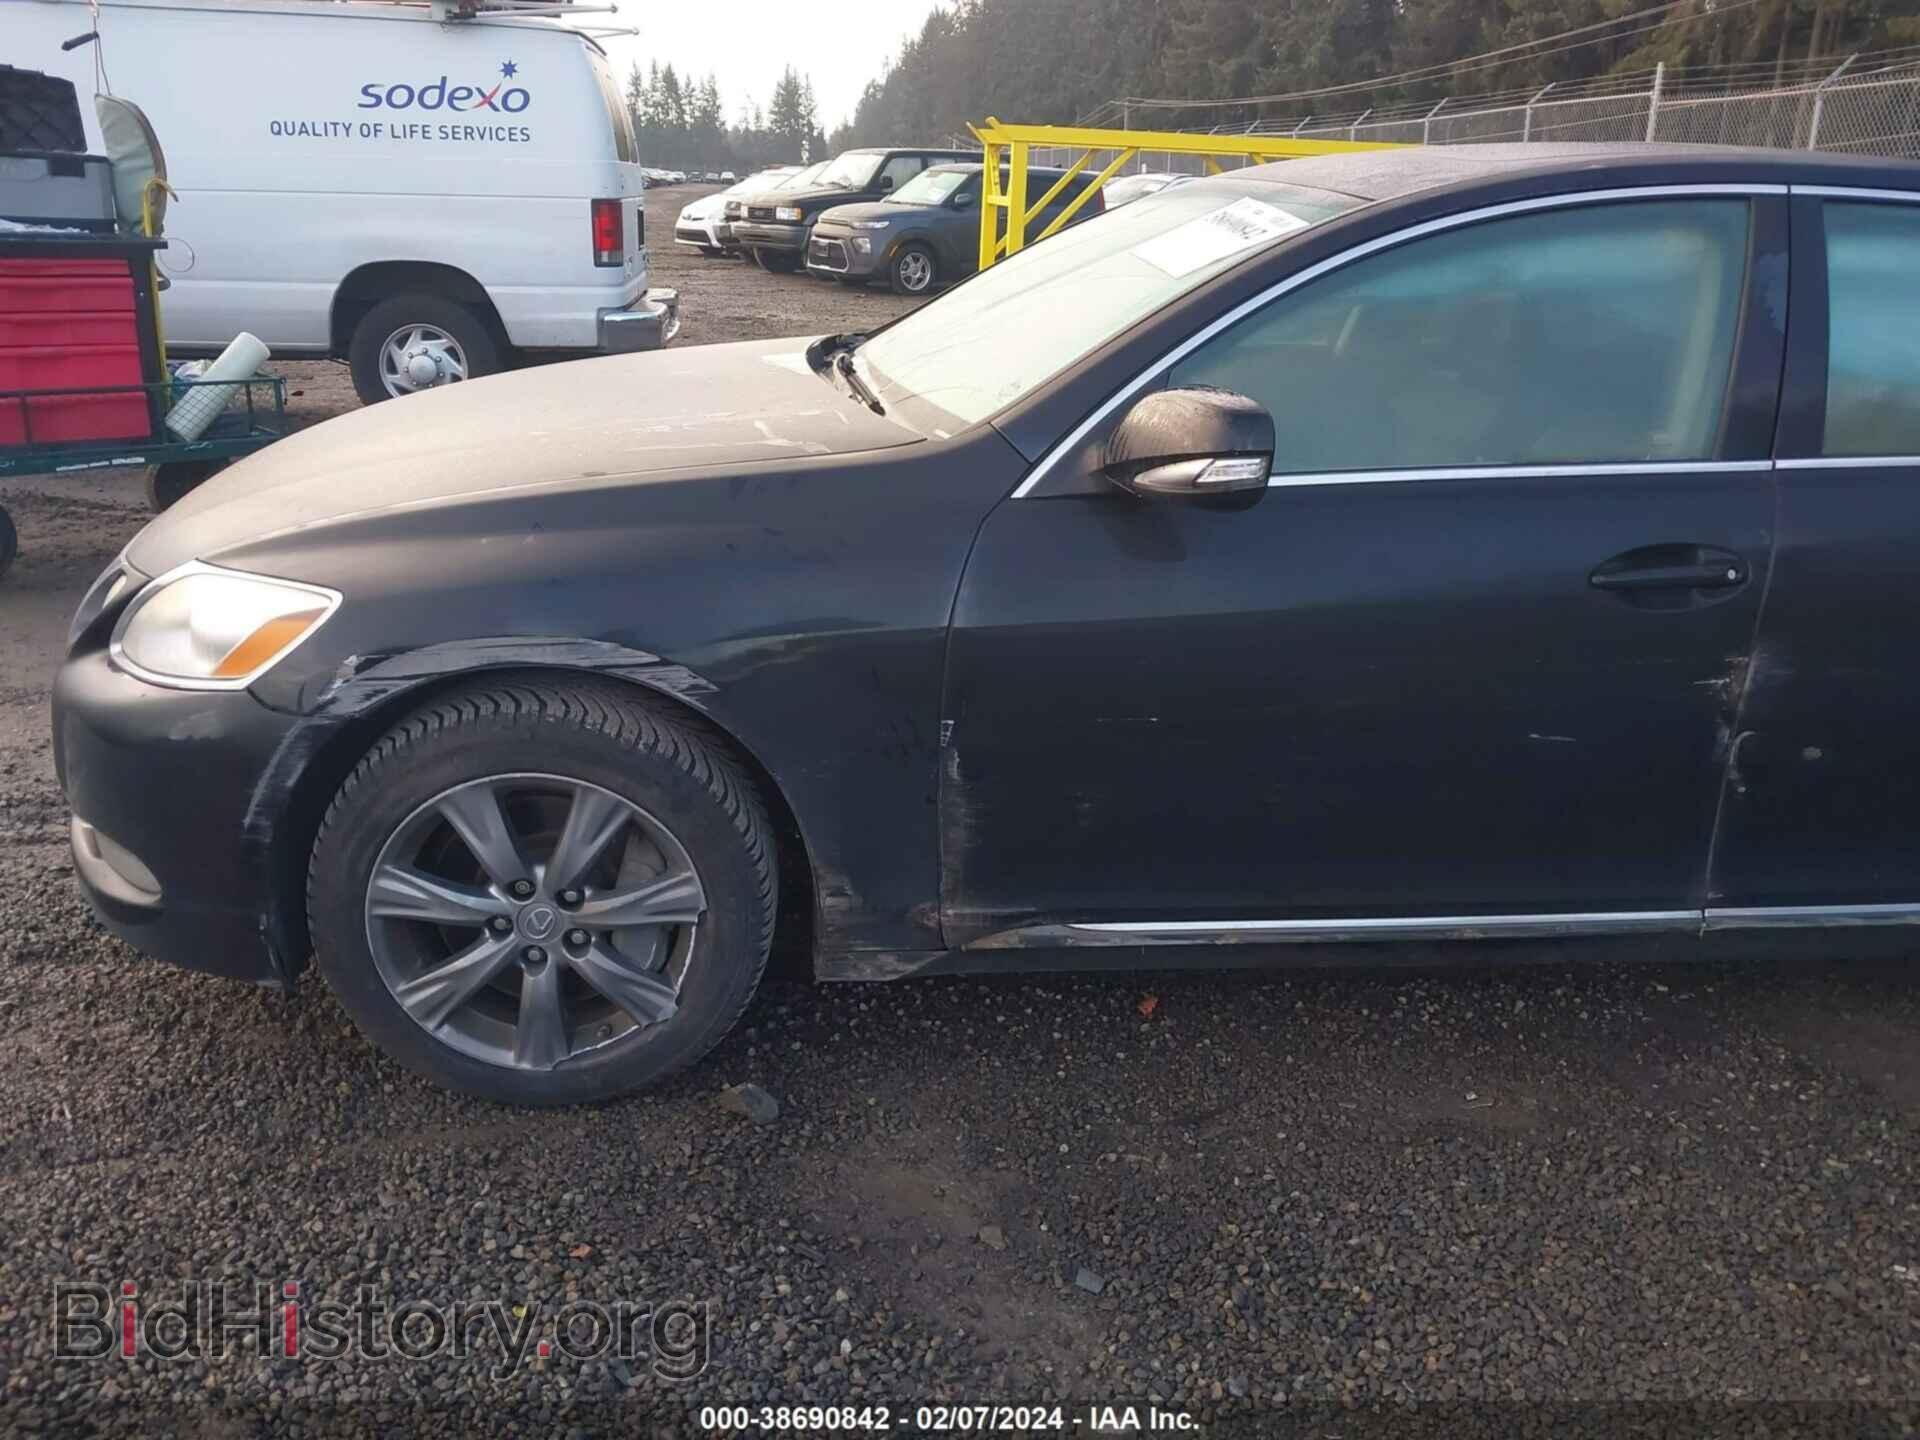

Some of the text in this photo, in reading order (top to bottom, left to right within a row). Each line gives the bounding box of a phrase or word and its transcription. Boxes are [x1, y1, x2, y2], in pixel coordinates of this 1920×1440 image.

[357, 75, 531, 113] sodexo
[270, 120, 531, 142] QUALITY OF LIFE SERVICES
